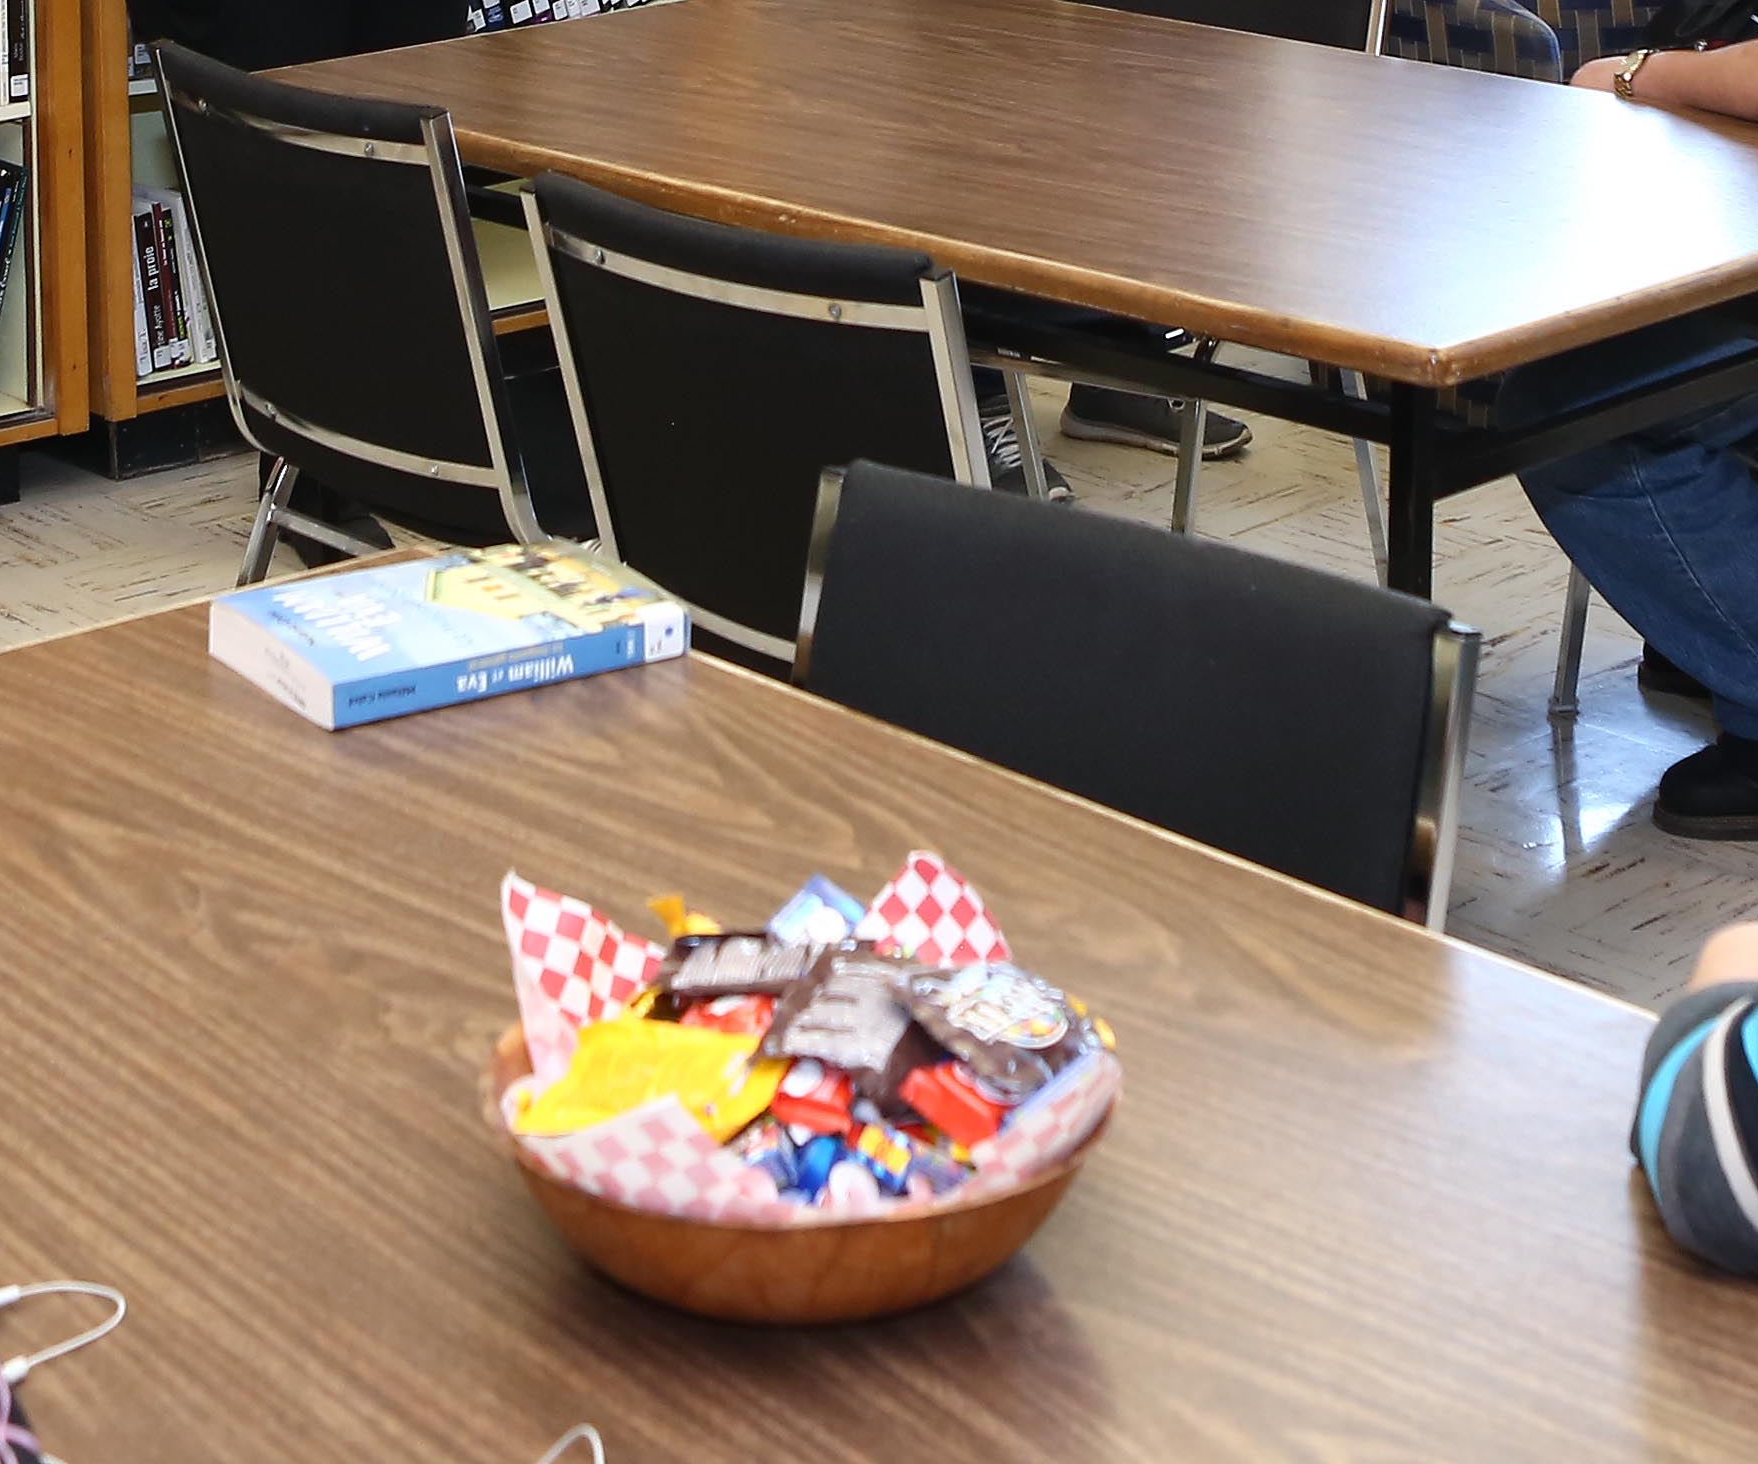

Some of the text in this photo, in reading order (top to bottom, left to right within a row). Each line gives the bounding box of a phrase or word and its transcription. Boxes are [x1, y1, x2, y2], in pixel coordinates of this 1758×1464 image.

[143, 246, 161, 291] la proie
[456, 674, 490, 694] Eva
[509, 654, 576, 686] William
